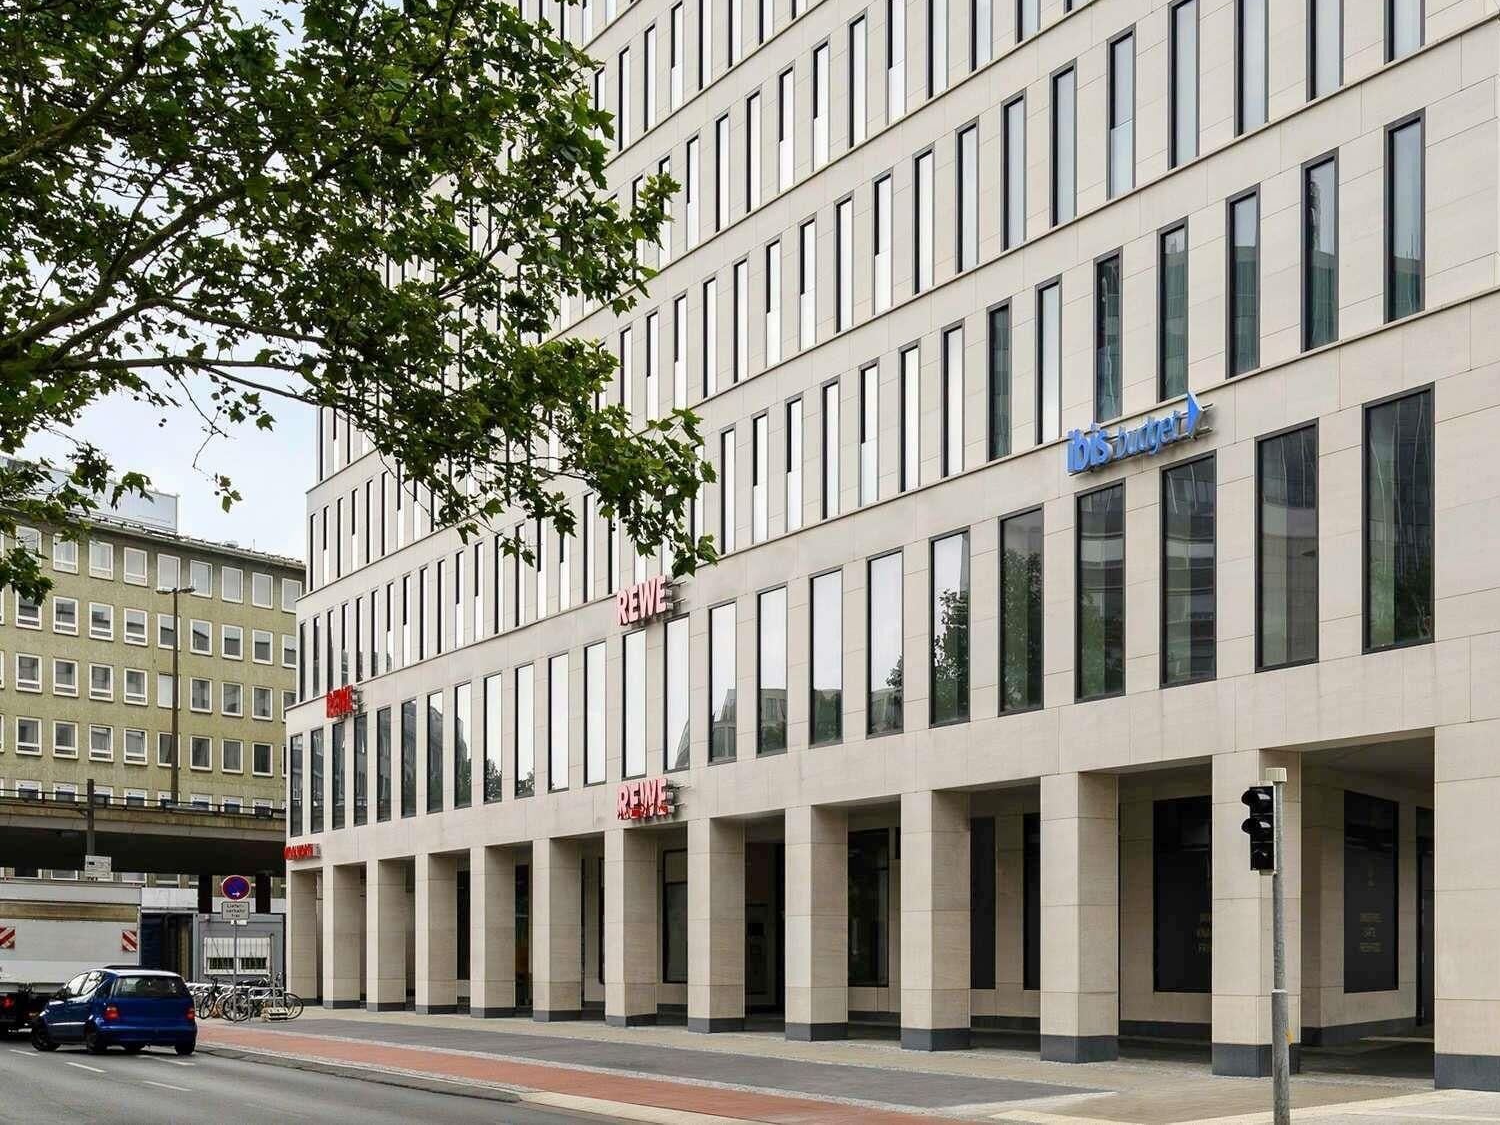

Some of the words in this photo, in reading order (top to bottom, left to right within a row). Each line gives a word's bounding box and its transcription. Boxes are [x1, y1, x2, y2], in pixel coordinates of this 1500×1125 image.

[1067, 423, 1113, 473] ibis
[1114, 411, 1182, 459] budget
[616, 574, 668, 626] REWE
[617, 777, 669, 820] REWE
